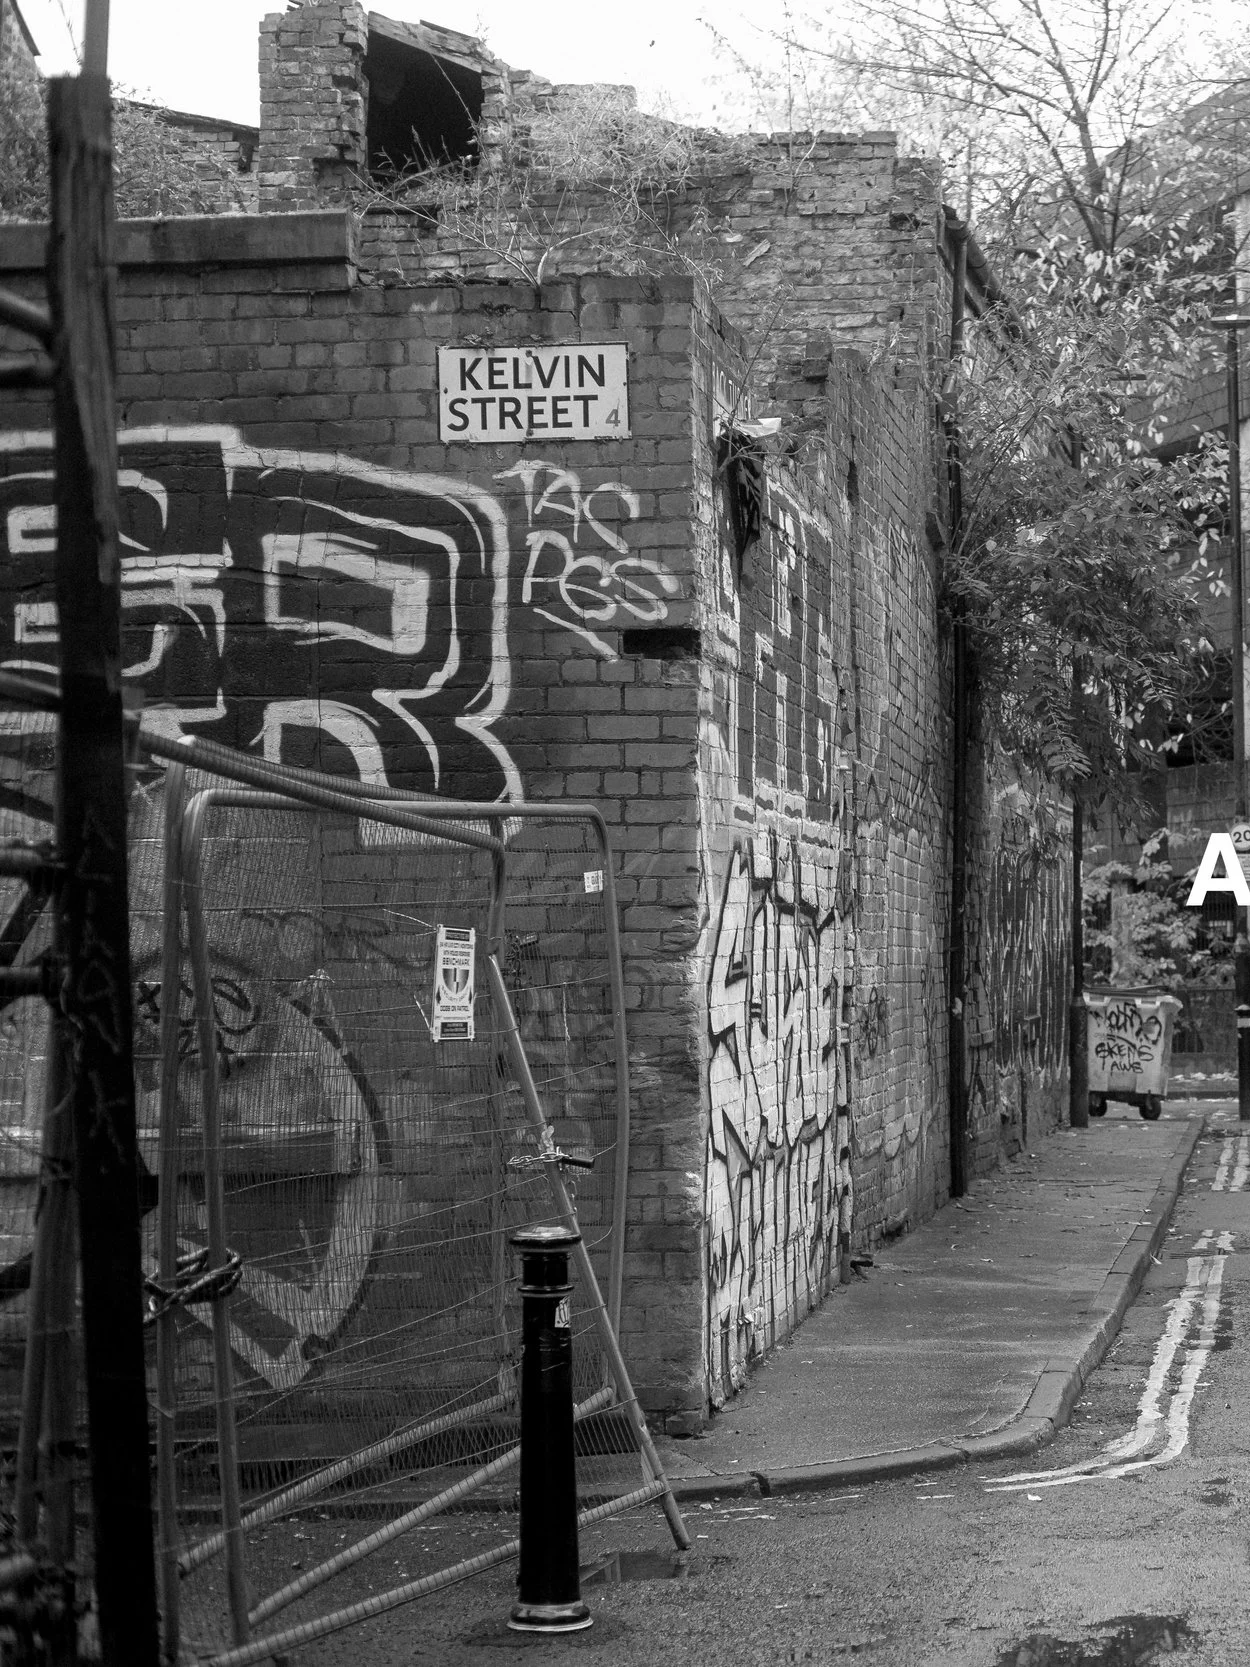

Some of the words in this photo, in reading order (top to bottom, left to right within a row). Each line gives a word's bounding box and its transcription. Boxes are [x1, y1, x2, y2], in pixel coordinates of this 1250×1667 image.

[459, 354, 606, 391] KELVIN
[446, 394, 599, 432] STREET
[605, 408, 621, 427] 4
